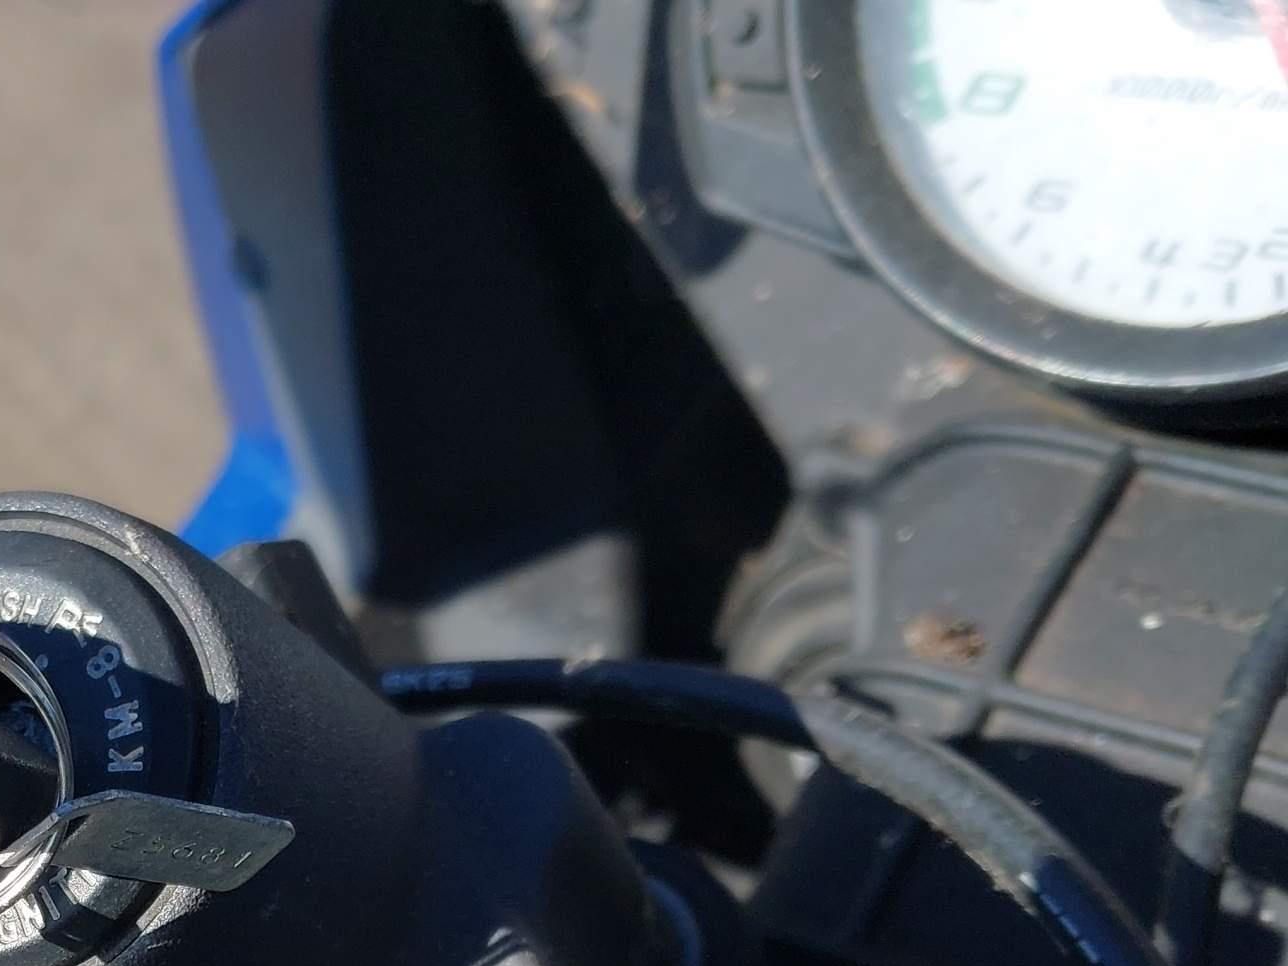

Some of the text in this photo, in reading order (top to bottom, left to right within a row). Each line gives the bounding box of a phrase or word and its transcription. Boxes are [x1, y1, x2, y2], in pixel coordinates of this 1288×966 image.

[960, 72, 1026, 116] 8
[1026, 180, 1073, 213] 6
[1140, 237, 1185, 271] 4
[1198, 239, 1250, 274] 3
[85, 643, 145, 773] KM-8
